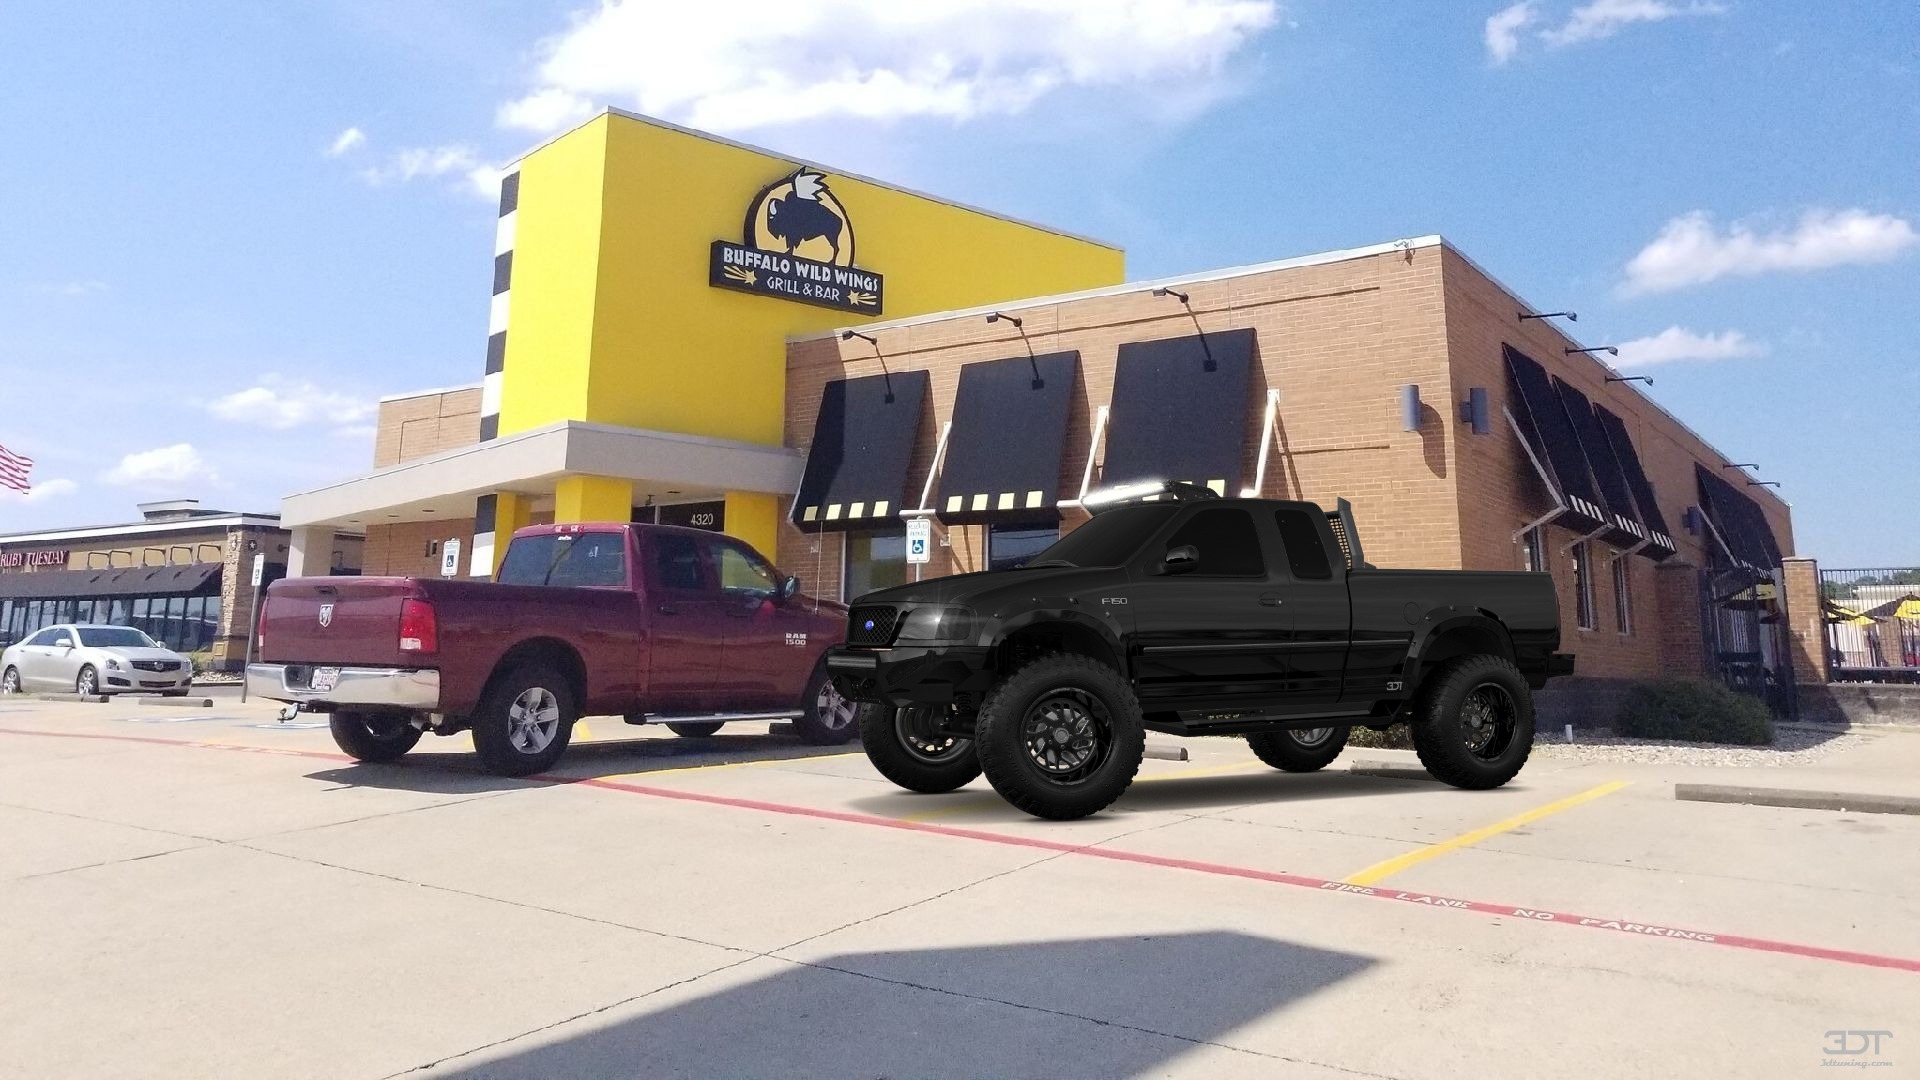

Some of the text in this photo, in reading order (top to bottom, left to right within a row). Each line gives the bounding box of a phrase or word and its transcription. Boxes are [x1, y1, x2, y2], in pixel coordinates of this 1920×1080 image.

[723, 247, 878, 292] BUFFALO WILD WINGS
[766, 276, 840, 302] GRILL & BAR
[690, 513, 714, 525] 4320
[0, 551, 66, 567] RUBY TUESDAY
[1386, 681, 1403, 691] 3DT
[1320, 882, 1716, 943] FIRE LANE NO PARKING
